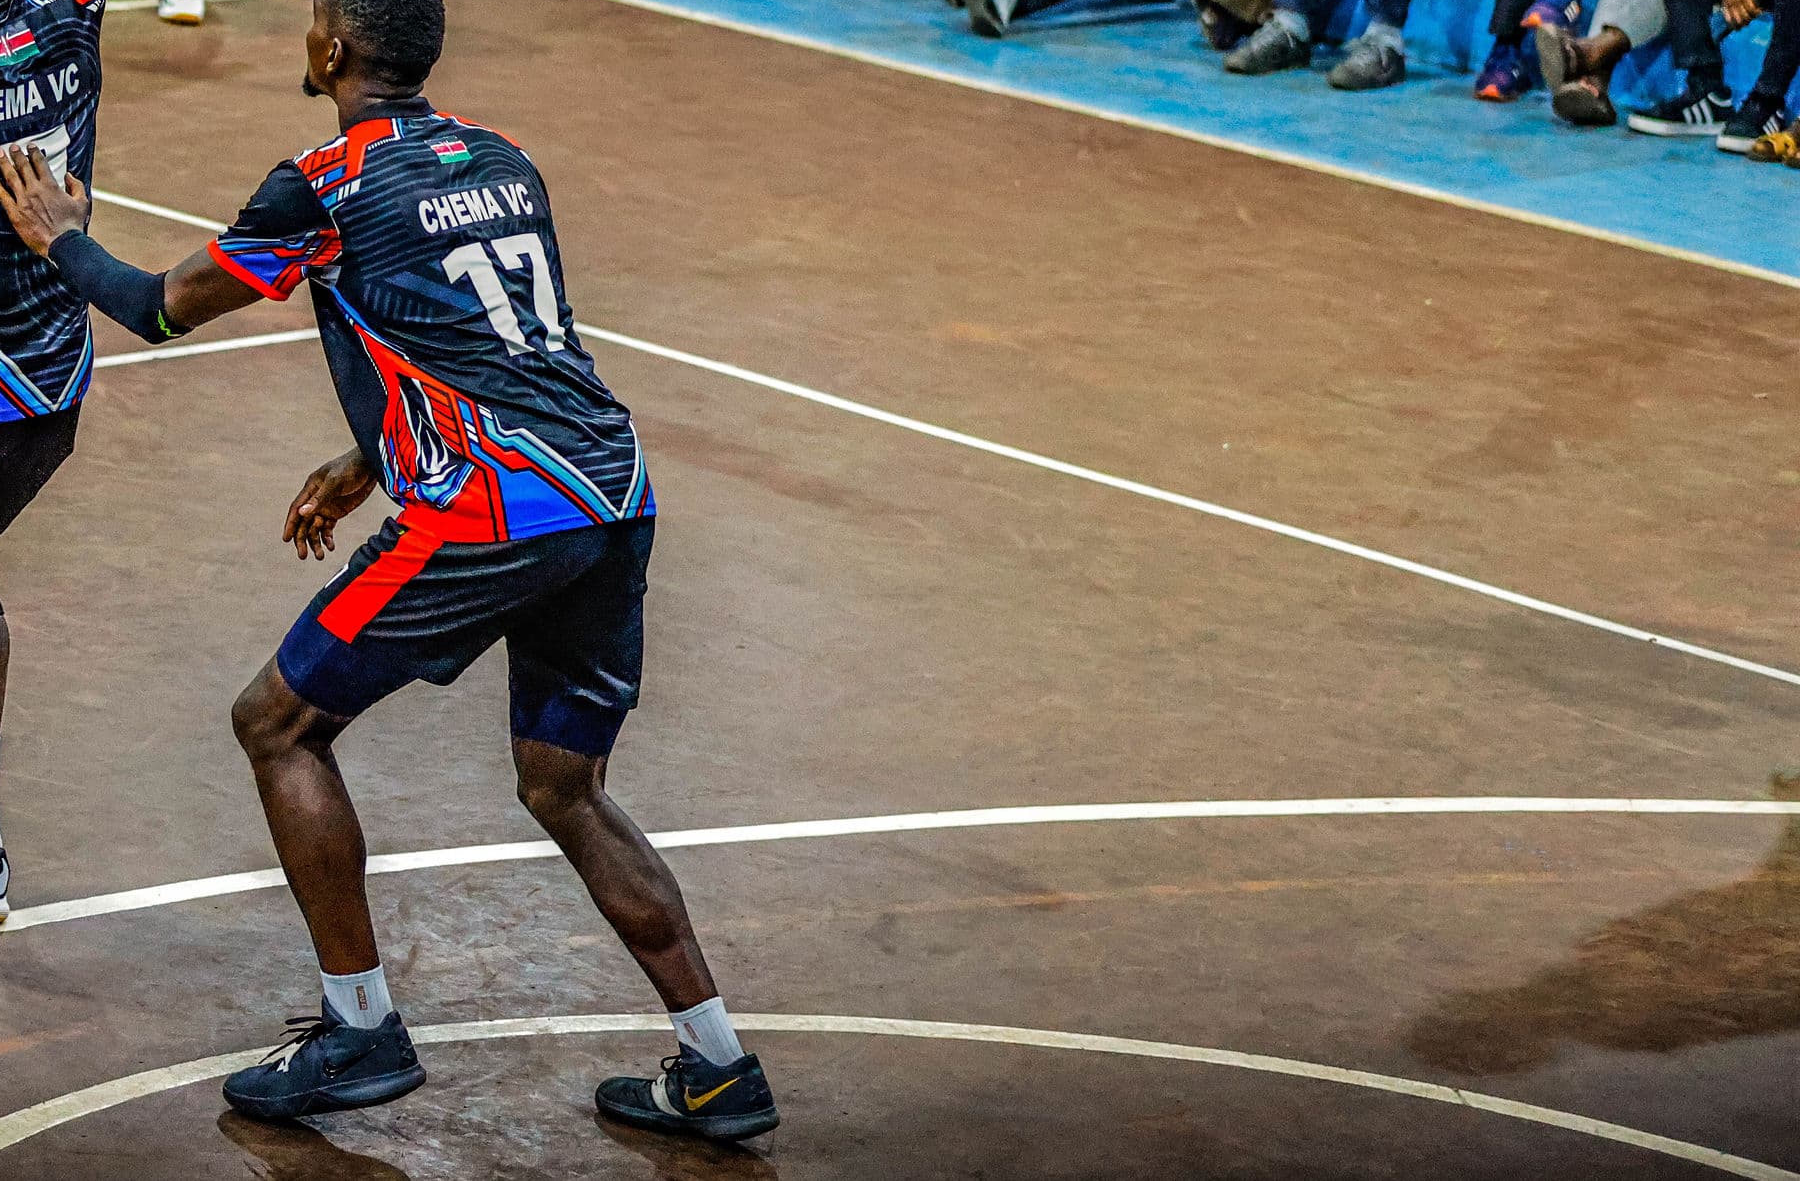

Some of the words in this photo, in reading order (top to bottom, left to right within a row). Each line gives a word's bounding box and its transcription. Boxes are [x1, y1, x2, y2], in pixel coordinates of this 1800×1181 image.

[47, 62, 80, 103] VC
[418, 187, 506, 234] CHEMA
[498, 182, 534, 216] VC
[441, 233, 566, 356] 17
